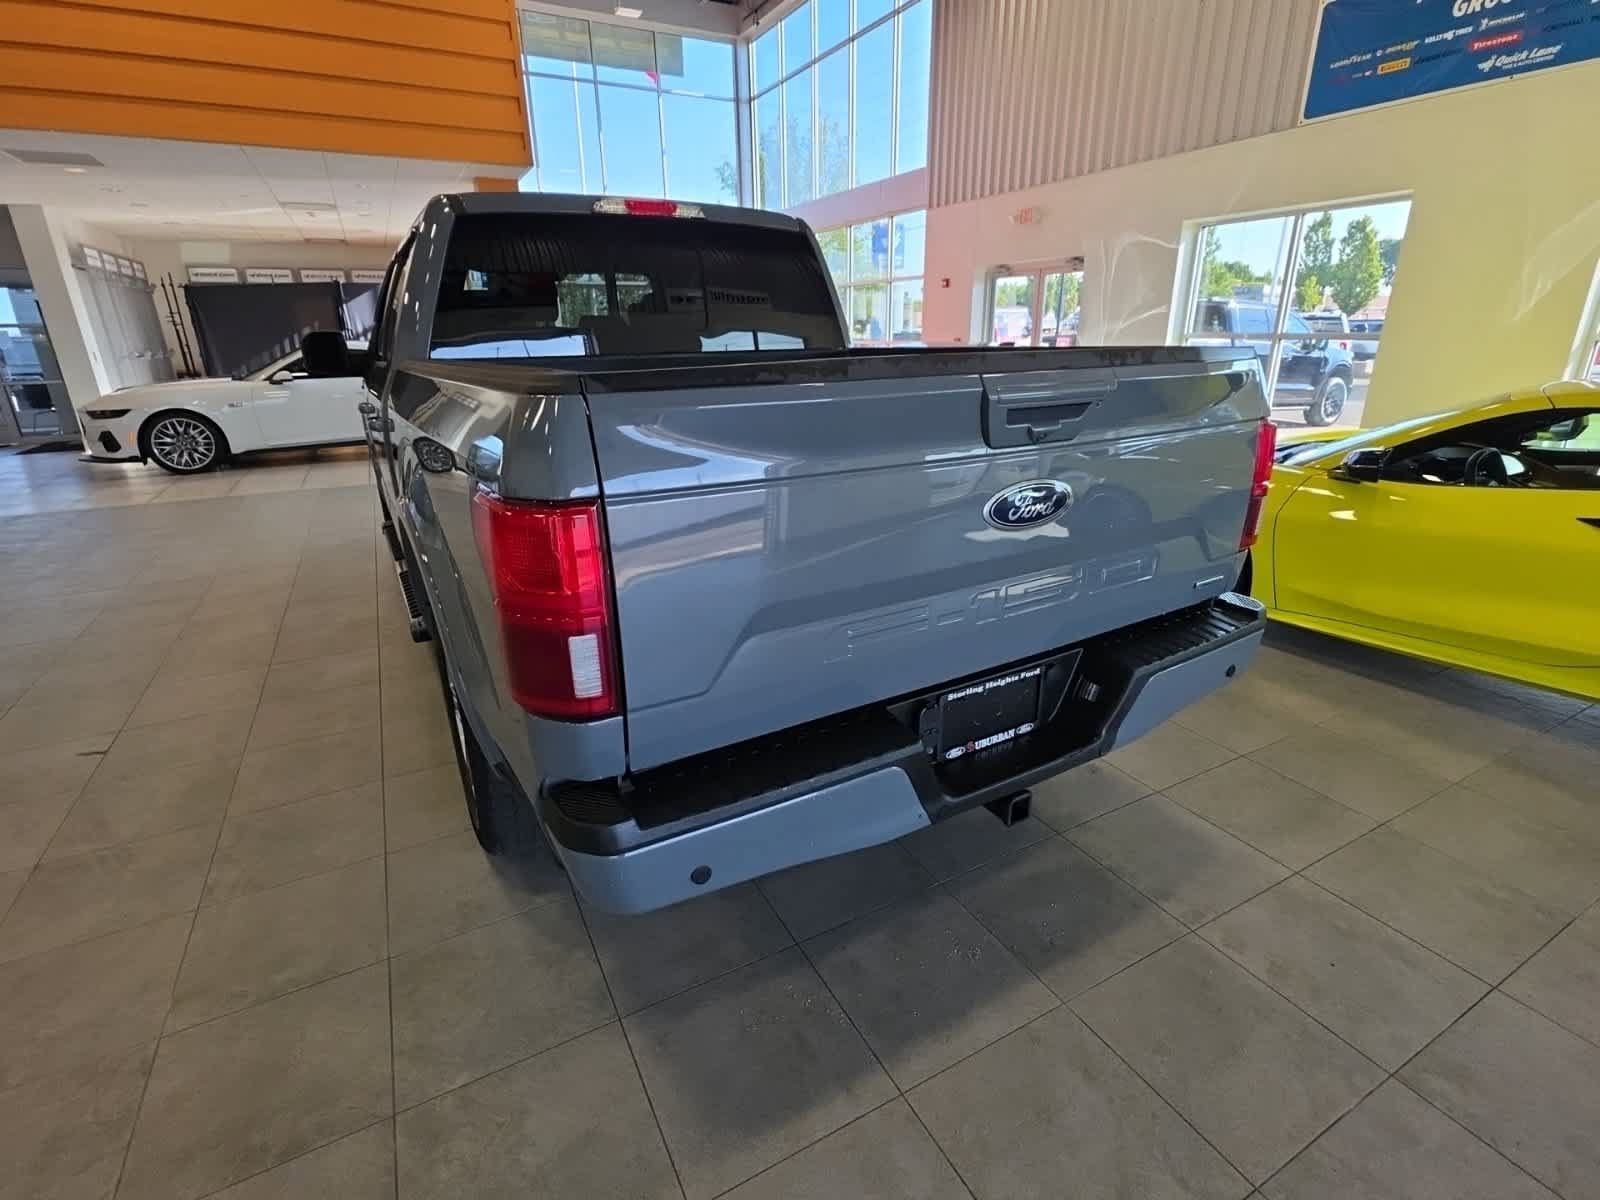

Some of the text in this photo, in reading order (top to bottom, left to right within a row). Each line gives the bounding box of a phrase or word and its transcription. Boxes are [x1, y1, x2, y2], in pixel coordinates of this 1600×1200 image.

[1495, 50, 1529, 67] Quick
[1008, 490, 1058, 521] Ford
[823, 544, 1160, 664] F-150
[947, 667, 1041, 701] Sterling Heights Ford
[966, 728, 1016, 753] SUBURBAN
